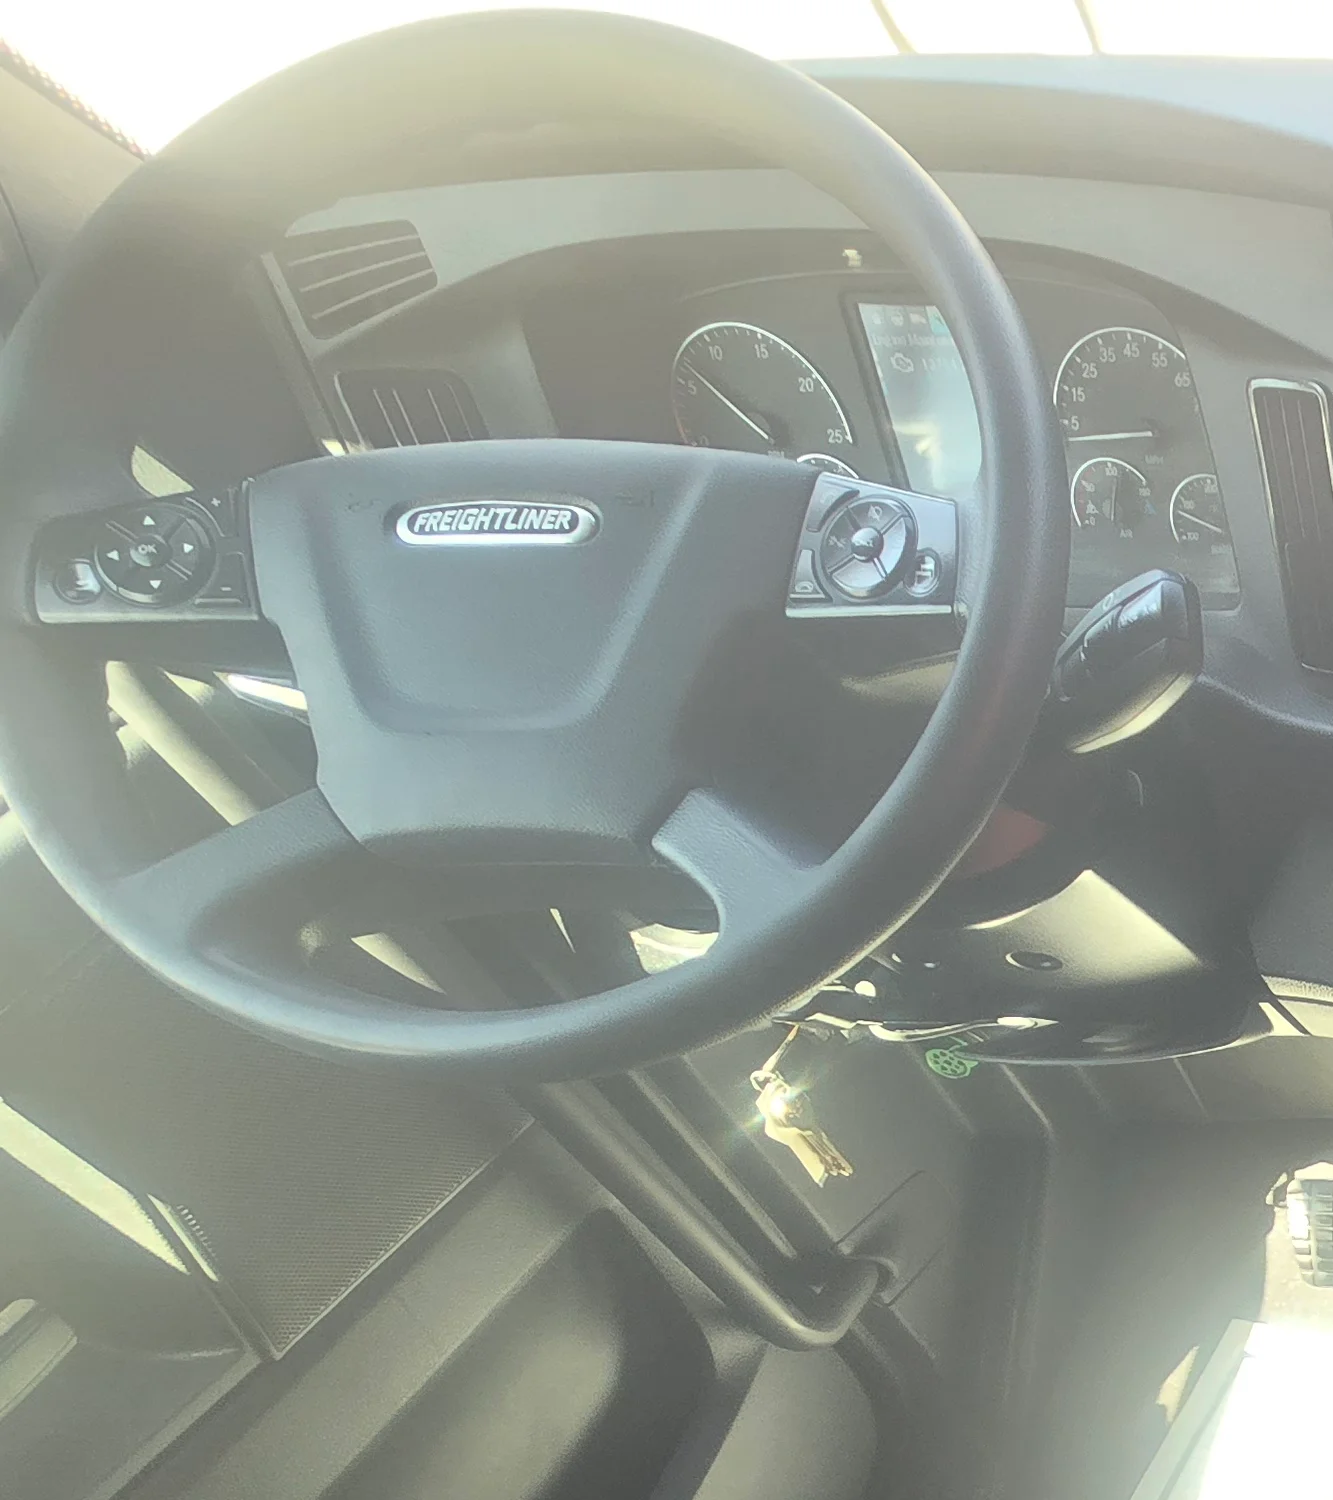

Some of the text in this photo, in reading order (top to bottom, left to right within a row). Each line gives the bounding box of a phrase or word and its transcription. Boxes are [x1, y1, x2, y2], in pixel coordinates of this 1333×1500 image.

[709, 345, 723, 361] 10
[754, 344, 769, 359] 15
[1099, 347, 1116, 363] 35
[1123, 343, 1140, 358] 45
[1152, 352, 1168, 367] 55
[1081, 363, 1098, 379] 25
[687, 380, 697, 396] 5
[798, 377, 814, 393] 20
[1174, 372, 1192, 388] 65
[1071, 387, 1086, 402] 15
[1070, 416, 1080, 430] 5
[827, 428, 843, 444] 25
[413, 507, 571, 533] FREIGHTLINER
[137, 544, 158, 555] OK
